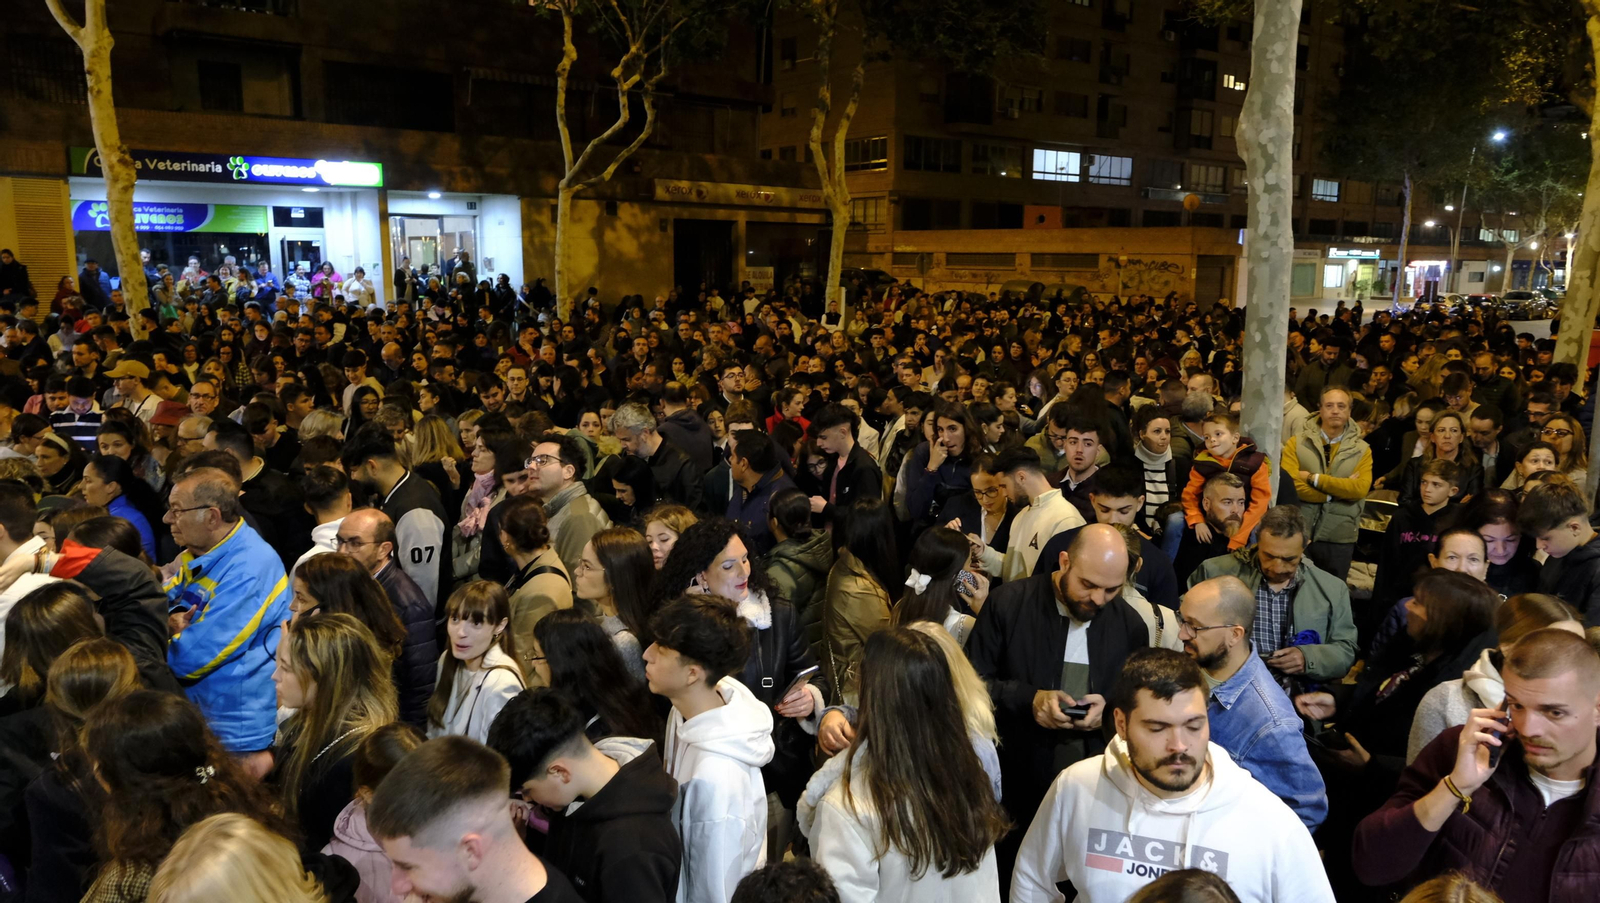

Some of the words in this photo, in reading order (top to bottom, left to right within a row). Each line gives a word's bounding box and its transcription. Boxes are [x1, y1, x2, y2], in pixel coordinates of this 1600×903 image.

[145, 158, 223, 173] Veterinaria
[664, 184, 693, 195] xerox
[735, 189, 762, 199] xerox
[410, 546, 435, 564] 07
